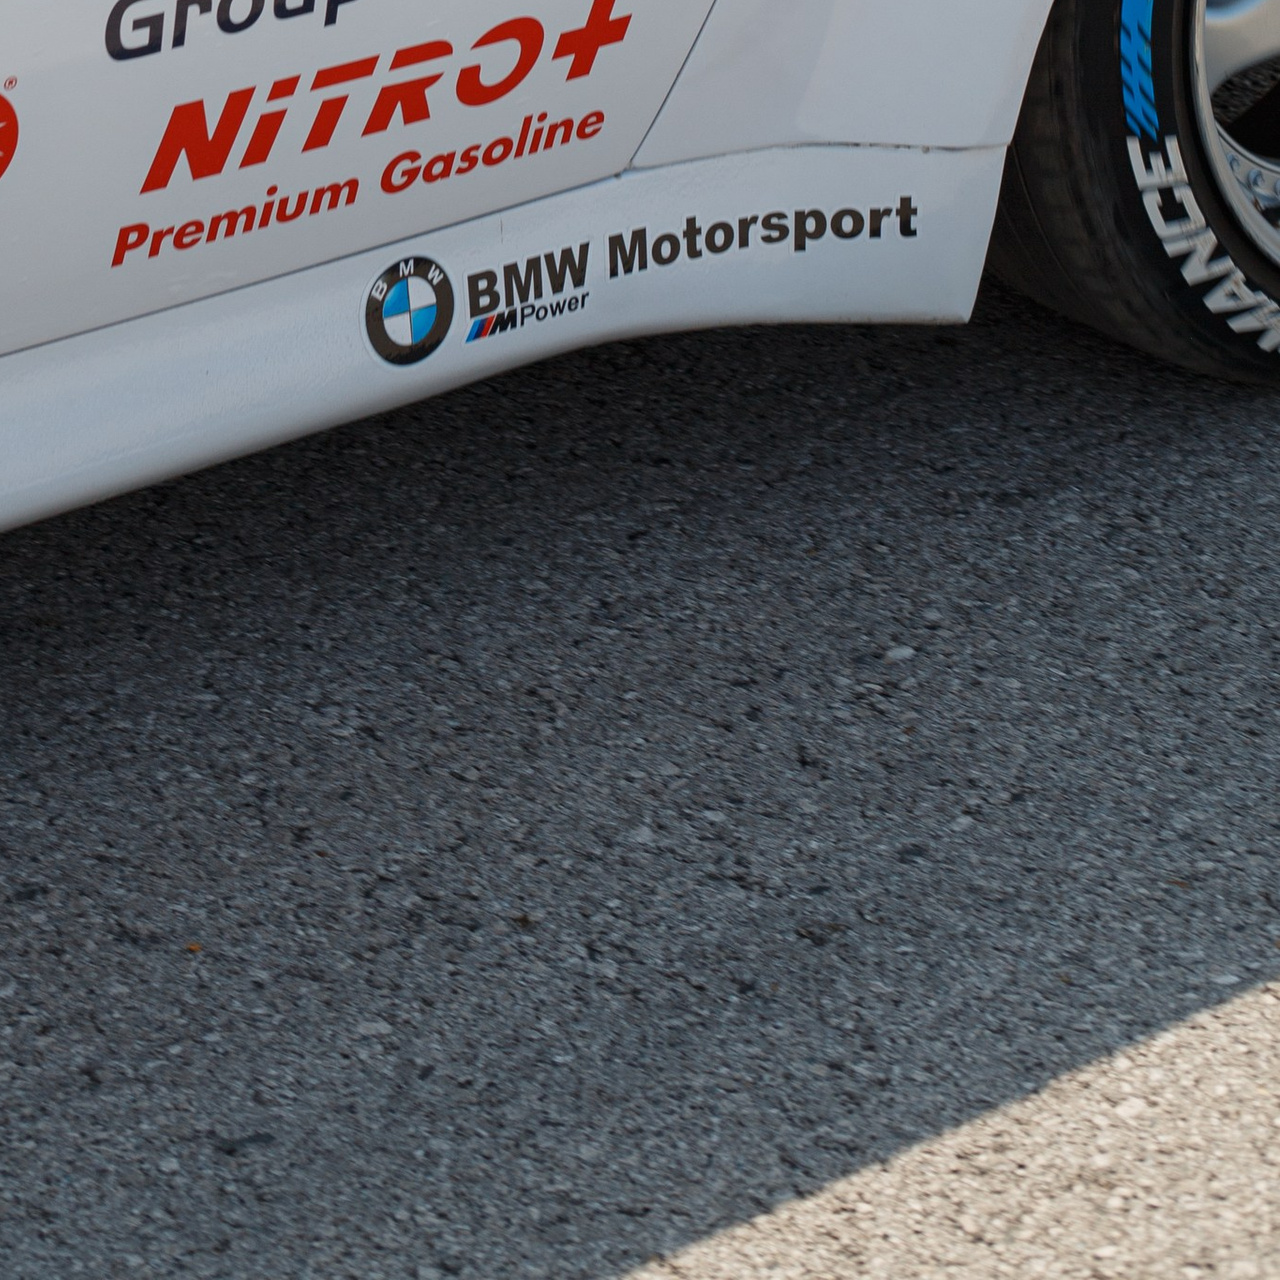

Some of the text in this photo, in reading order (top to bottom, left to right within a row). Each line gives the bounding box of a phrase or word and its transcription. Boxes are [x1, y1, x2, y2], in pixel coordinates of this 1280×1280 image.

[111, 109, 605, 268] Premium Gasoline
[371, 259, 444, 302] BMW
[467, 196, 917, 318] BMW Motorsport
